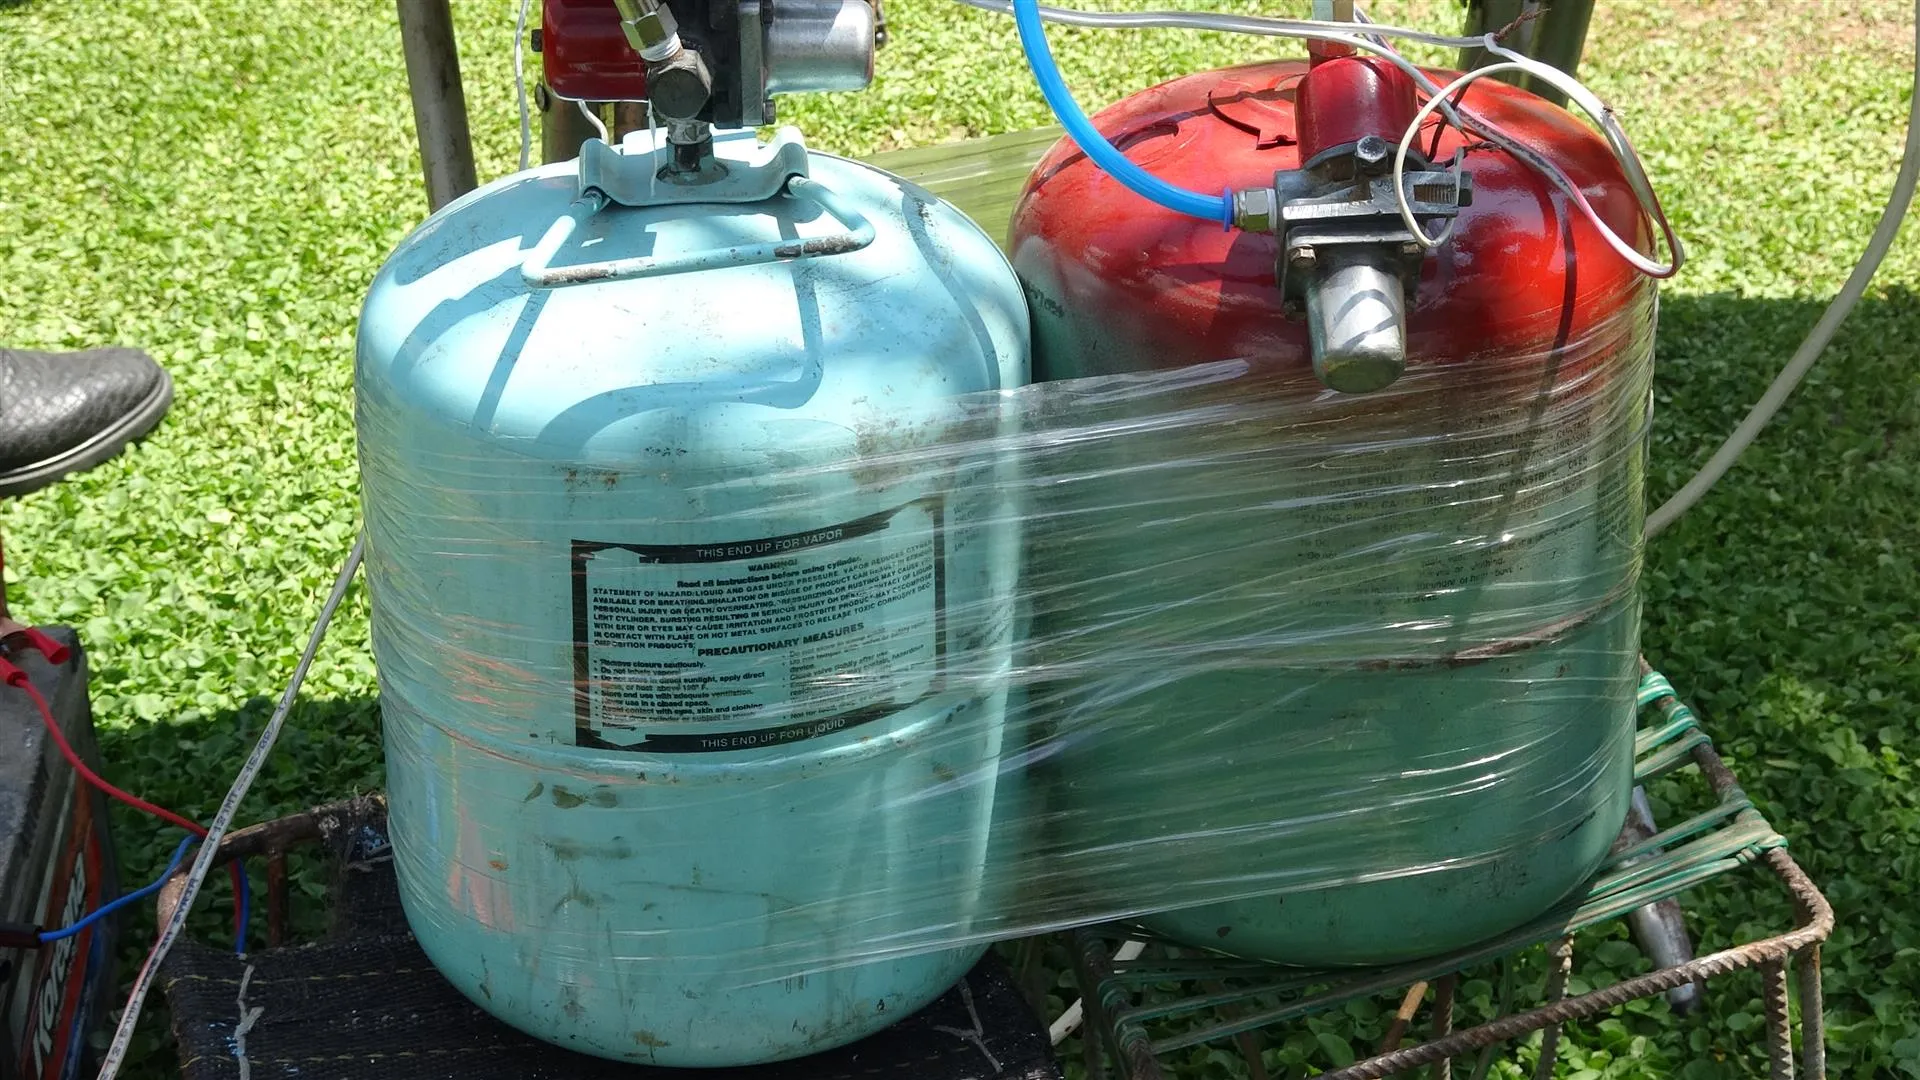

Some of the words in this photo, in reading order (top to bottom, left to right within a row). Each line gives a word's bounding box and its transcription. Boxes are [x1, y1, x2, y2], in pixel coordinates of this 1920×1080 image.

[696, 548, 724, 559] THIS
[727, 545, 753, 556] END
[756, 542, 772, 553] UP
[775, 538, 800, 550] FOR
[803, 529, 843, 545] VAPOR
[593, 587, 641, 597] STATEMENT
[746, 584, 764, 593] GAS
[593, 596, 637, 606] AVAILABLE
[757, 592, 769, 600] OR
[771, 587, 801, 598] MISUSE
[803, 584, 813, 592] OF
[815, 576, 851, 590] PRODUCT
[677, 580, 701, 588] Read
[703, 579, 714, 587] all
[771, 570, 800, 580] before
[593, 605, 635, 614] PERSONAL
[881, 569, 896, 579] MAY
[593, 622, 613, 630] WITH
[616, 623, 635, 631] SKIN
[696, 623, 724, 631] CAUSE
[726, 618, 772, 629] IRRITATION
[775, 615, 791, 623] AND
[794, 606, 836, 619] FROSTBITE
[604, 632, 642, 640] CONTACT
[731, 629, 758, 637] METAL
[760, 622, 802, 634] SURFACES
[805, 619, 815, 627] TO
[817, 610, 851, 623] RELEASE
[855, 602, 875, 614] TOXIC
[704, 612, 749, 622] RESULTING
[798, 599, 825, 610] INJURY
[698, 638, 800, 657] PRECAUTIONARY
[803, 622, 865, 644] MEASURES
[633, 660, 662, 668] closure
[720, 674, 741, 682] apply
[743, 671, 765, 680] direct
[674, 692, 710, 700] adequate
[697, 706, 713, 714] skin
[702, 738, 728, 748] THIS
[732, 735, 757, 746] END
[760, 733, 776, 743] UP
[779, 729, 804, 740] FOR
[807, 719, 846, 736] LIQUID
